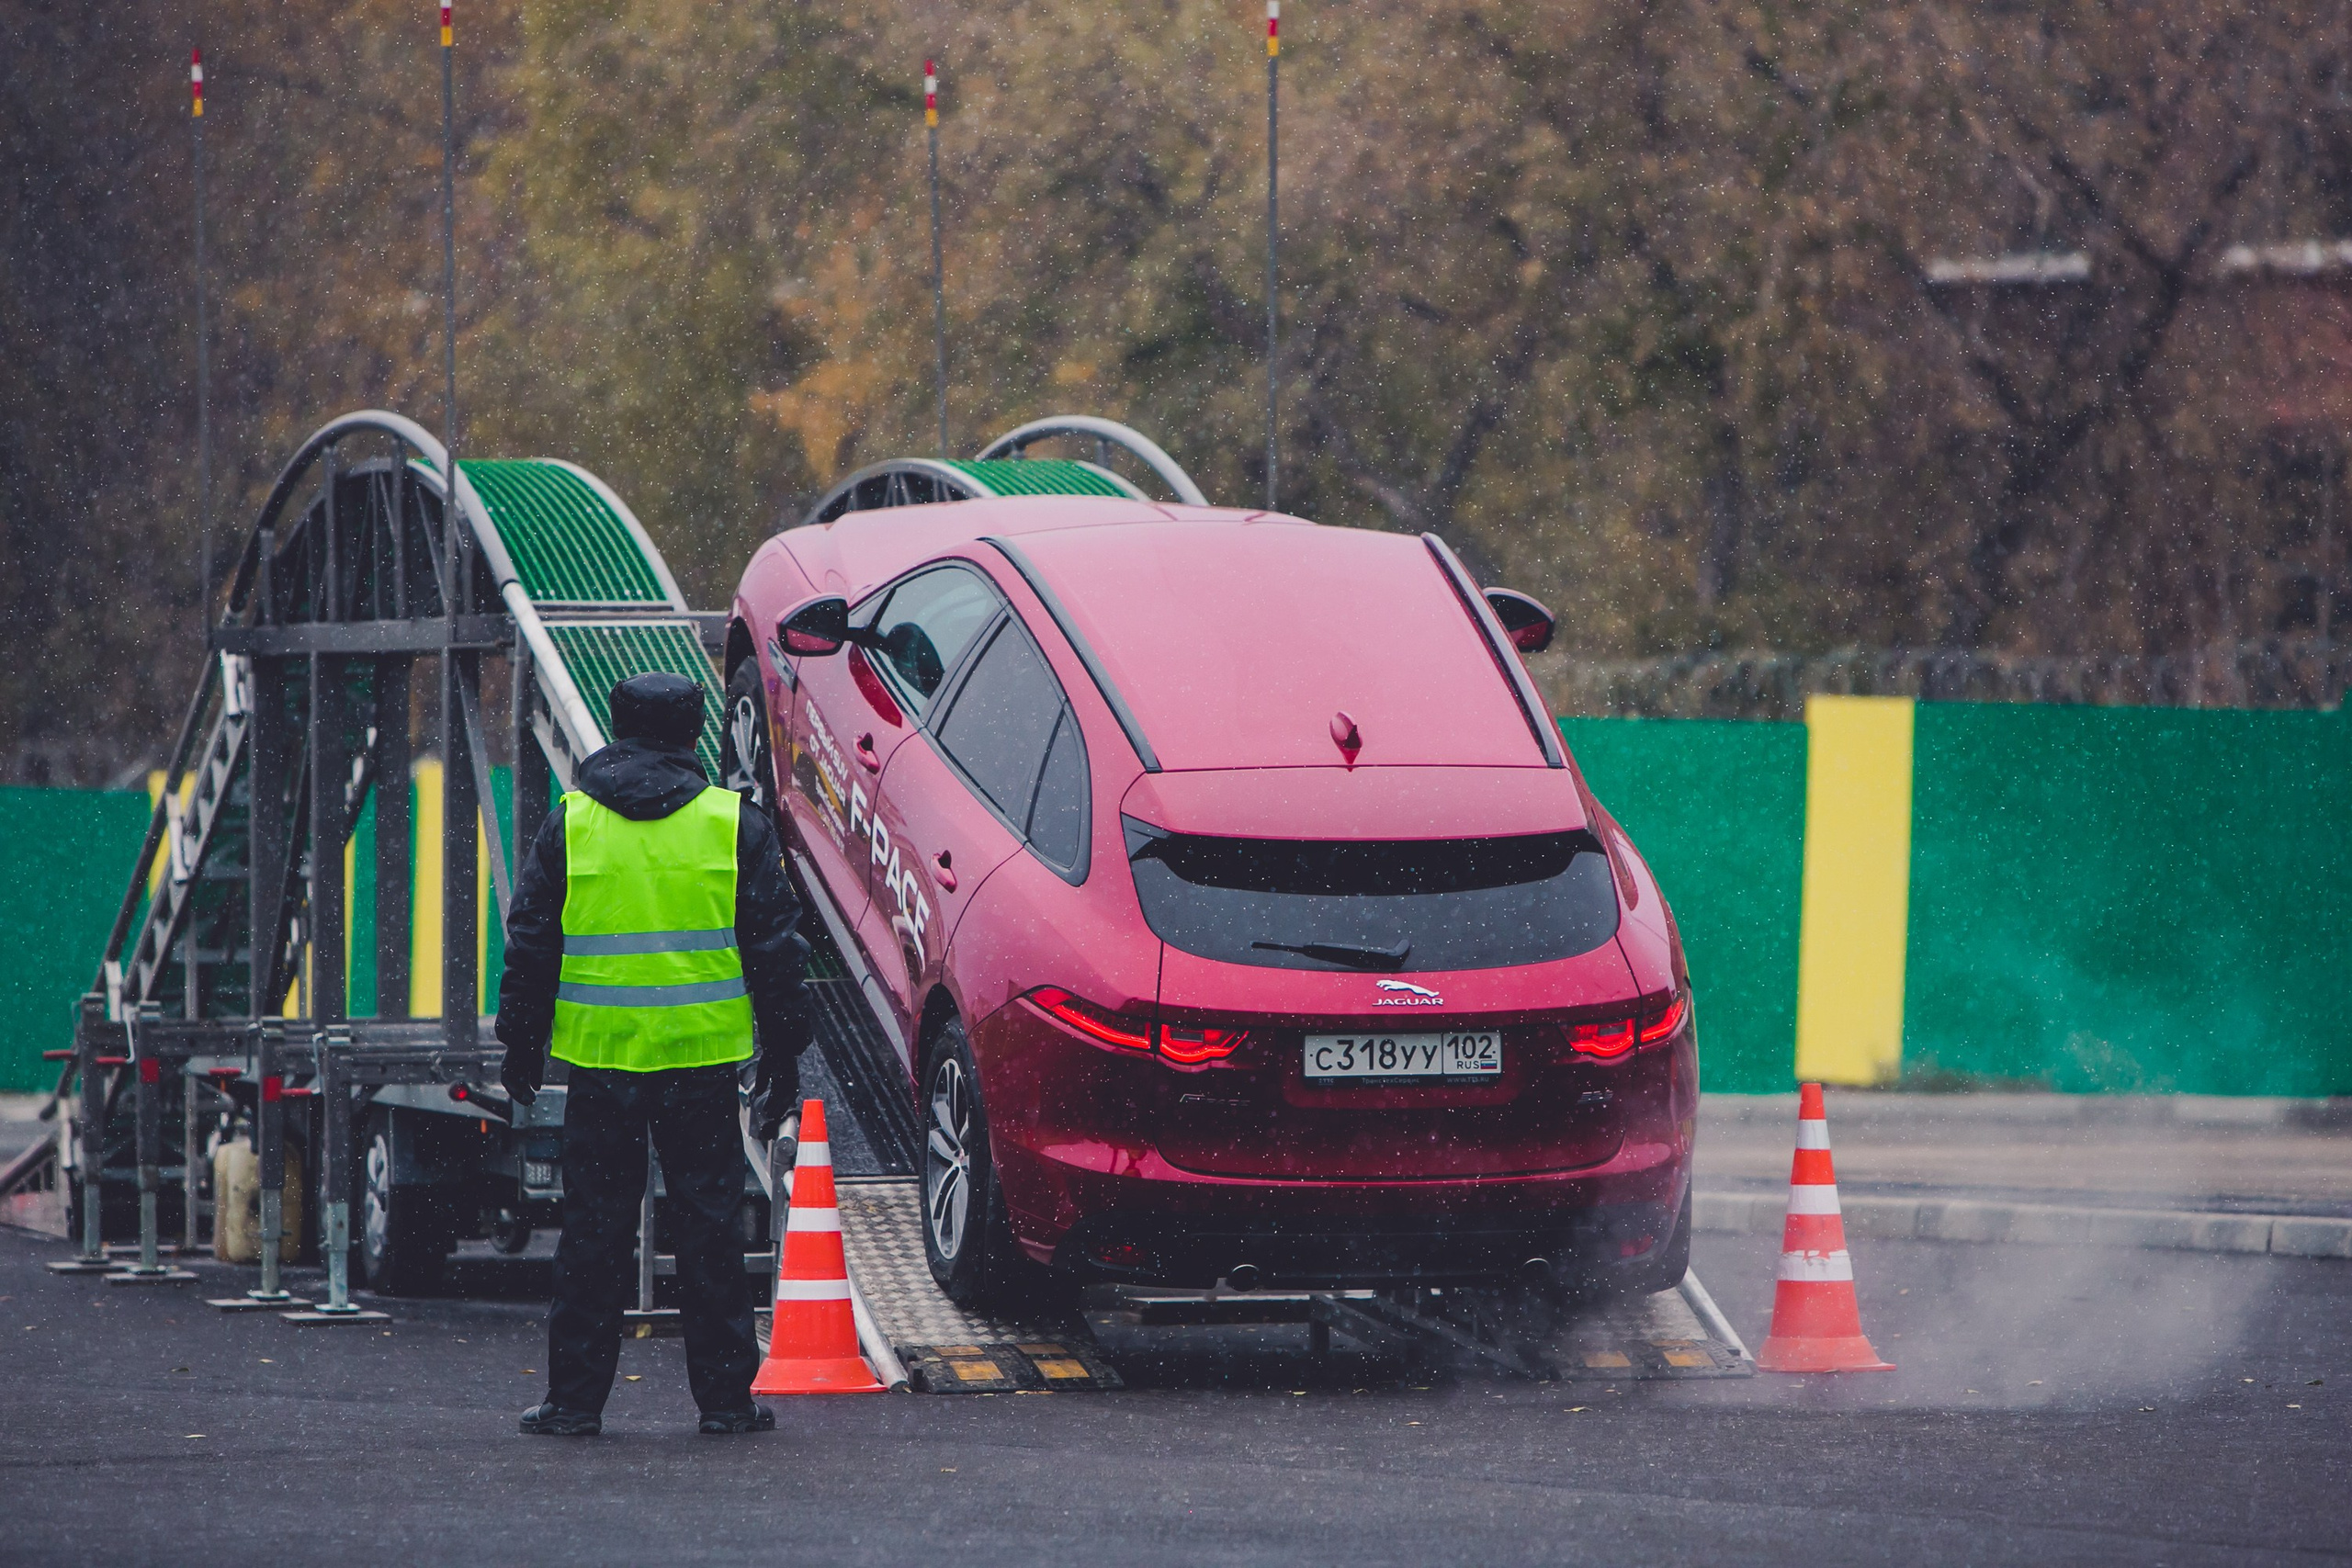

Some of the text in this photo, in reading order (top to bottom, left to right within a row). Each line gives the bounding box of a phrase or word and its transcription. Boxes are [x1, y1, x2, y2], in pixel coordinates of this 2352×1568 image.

[850, 780, 931, 973] F-PACE
[1372, 998, 1444, 1007] JAGUAR
[1446, 1035, 1493, 1060] 102
[1456, 1060, 1480, 1070] RUS
